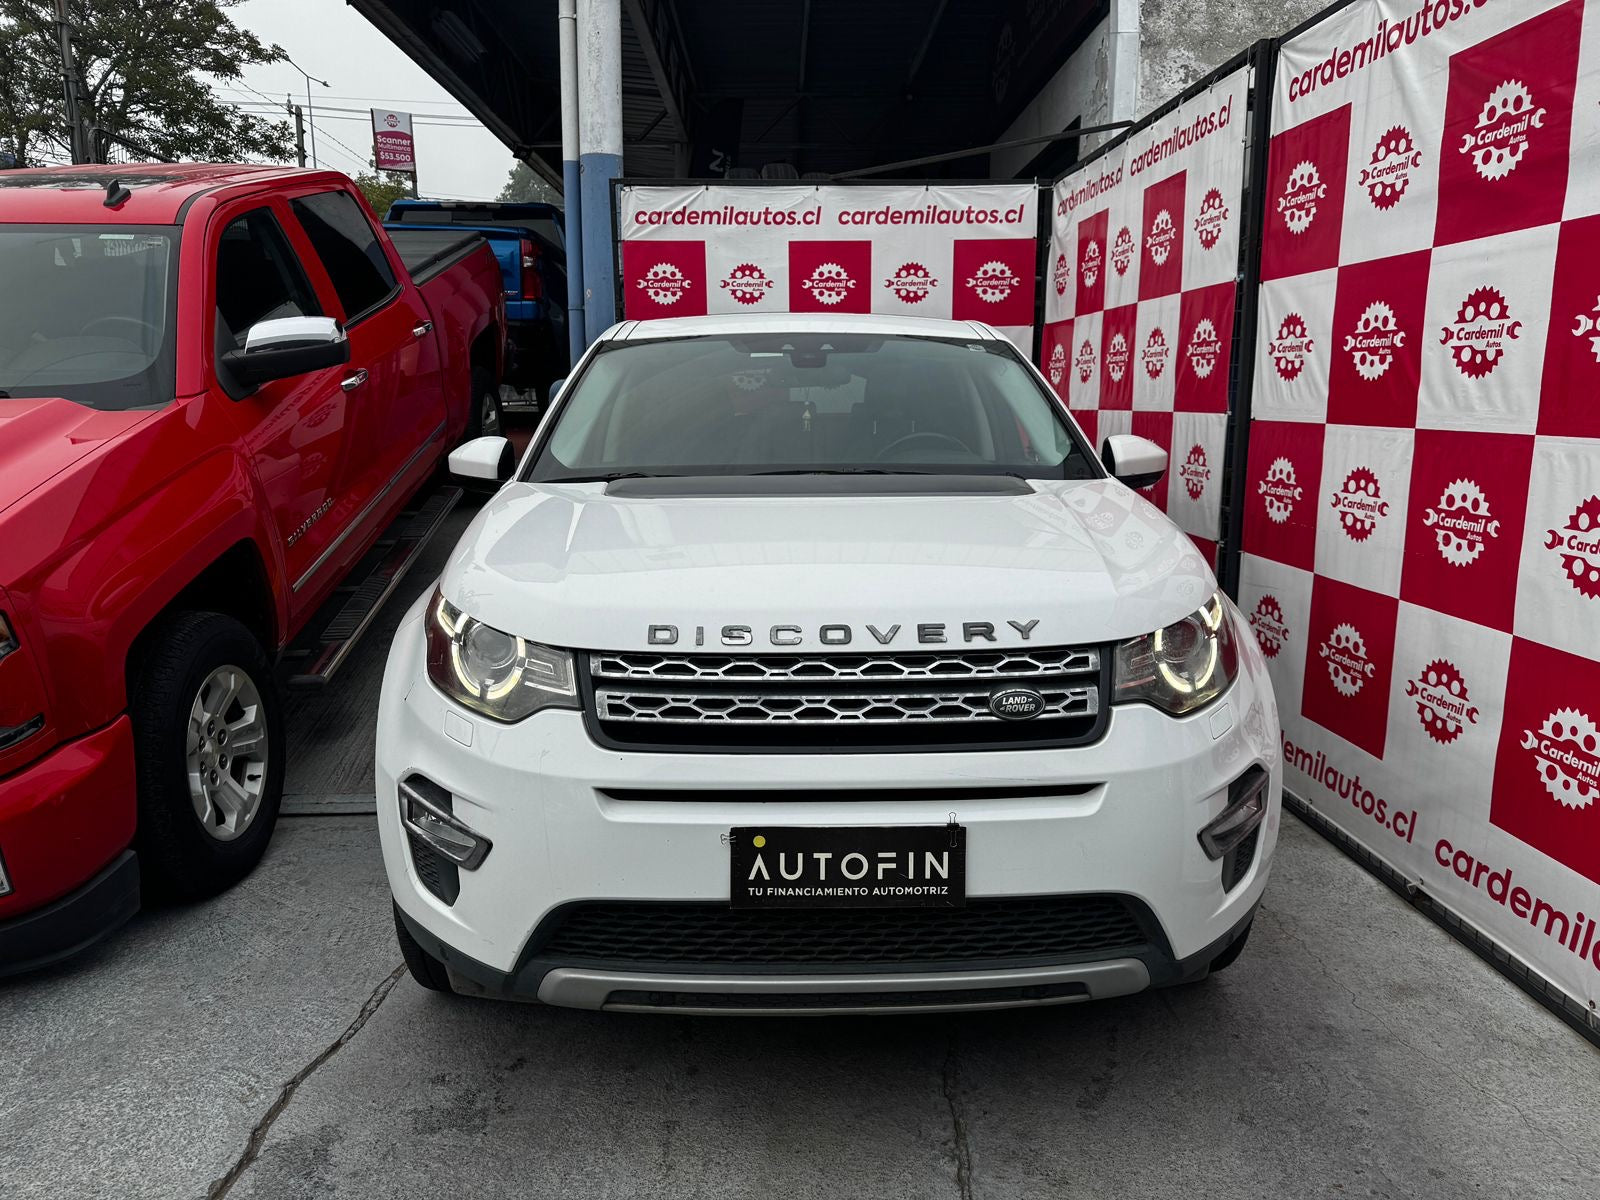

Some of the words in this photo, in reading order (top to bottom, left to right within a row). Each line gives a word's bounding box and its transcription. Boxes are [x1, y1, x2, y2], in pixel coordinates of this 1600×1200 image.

[1130, 95, 1233, 176] cardemilautos.cl
[1477, 114, 1530, 145] Cardemil
[377, 135, 411, 145] Scanner
[1508, 133, 1526, 145] Autos
[380, 151, 411, 161] $53.500
[1371, 155, 1410, 179] Cardemil
[1286, 187, 1317, 206] Cardemil
[634, 204, 821, 226] cardemilautos.cl
[838, 203, 1025, 226] cardemilautos.cl
[648, 279, 682, 288] Cardemil
[731, 279, 764, 288] Cardemil
[813, 279, 847, 288] Cardemil
[895, 279, 928, 287] Cardemil
[977, 278, 1010, 286] Cardemil
[1456, 323, 1505, 341] Cardemil
[1277, 340, 1304, 353] Cardemil
[1356, 333, 1393, 348] Cardemil
[1485, 340, 1502, 349] Autos
[1266, 484, 1294, 497] Cardemil
[1342, 497, 1378, 512] Cardemil
[287, 497, 334, 548] SILVERADO
[1439, 512, 1486, 533] Cardemil
[1466, 532, 1483, 542] Autos
[647, 619, 1041, 646] DISCOVERY
[1330, 648, 1364, 671] Cardemil
[1005, 703, 1036, 713] ROVER
[1420, 687, 1465, 716] Cardemil
[1541, 740, 1600, 778] Cardemil
[1576, 771, 1598, 787] Autos
[1281, 730, 1418, 844] emilautos.cl
[748, 851, 949, 881] AUTOFIN
[748, 887, 763, 897] TU
[767, 887, 869, 897] FINANCIAMIENTO
[872, 886, 949, 896] AUTOMOTRIZ
